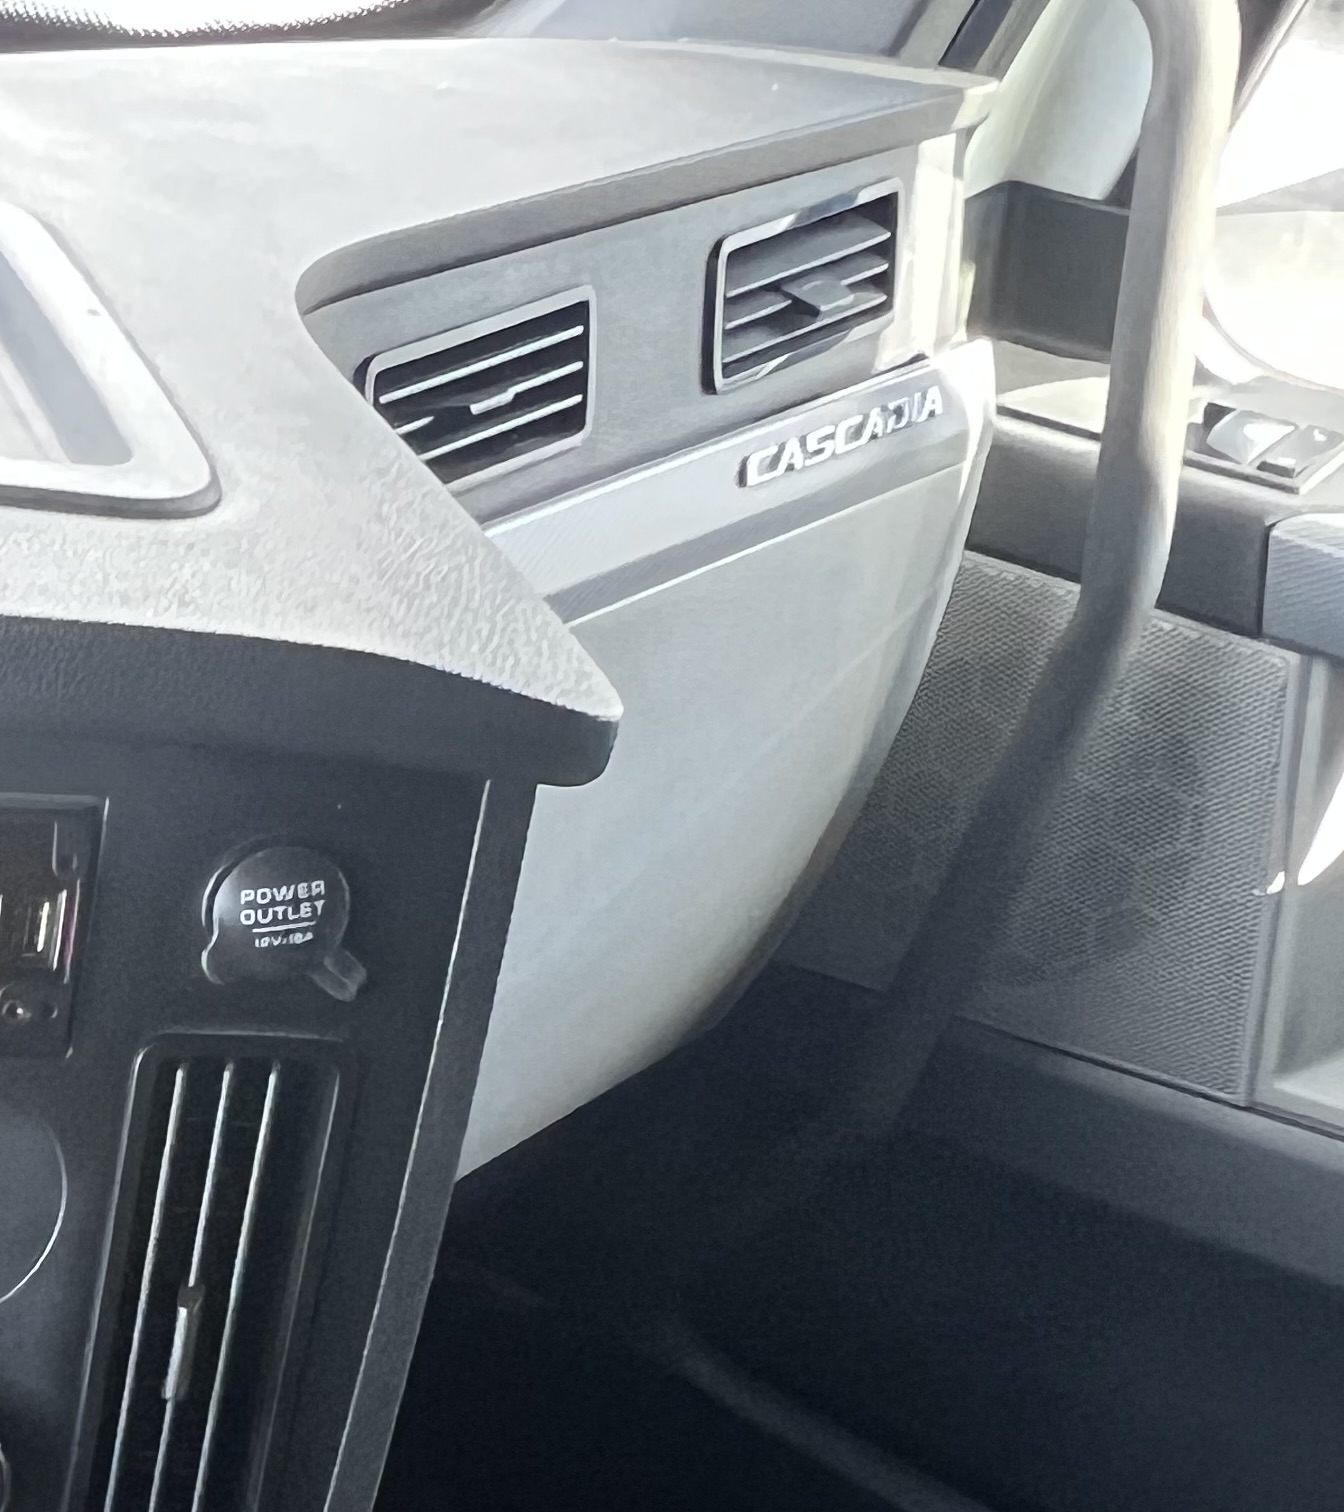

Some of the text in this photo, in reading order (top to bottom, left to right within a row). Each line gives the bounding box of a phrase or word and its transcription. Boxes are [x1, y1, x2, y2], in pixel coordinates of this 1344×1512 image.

[738, 385, 944, 487] CASCADIA
[239, 880, 326, 905] POWER
[239, 900, 326, 926] OUTLET
